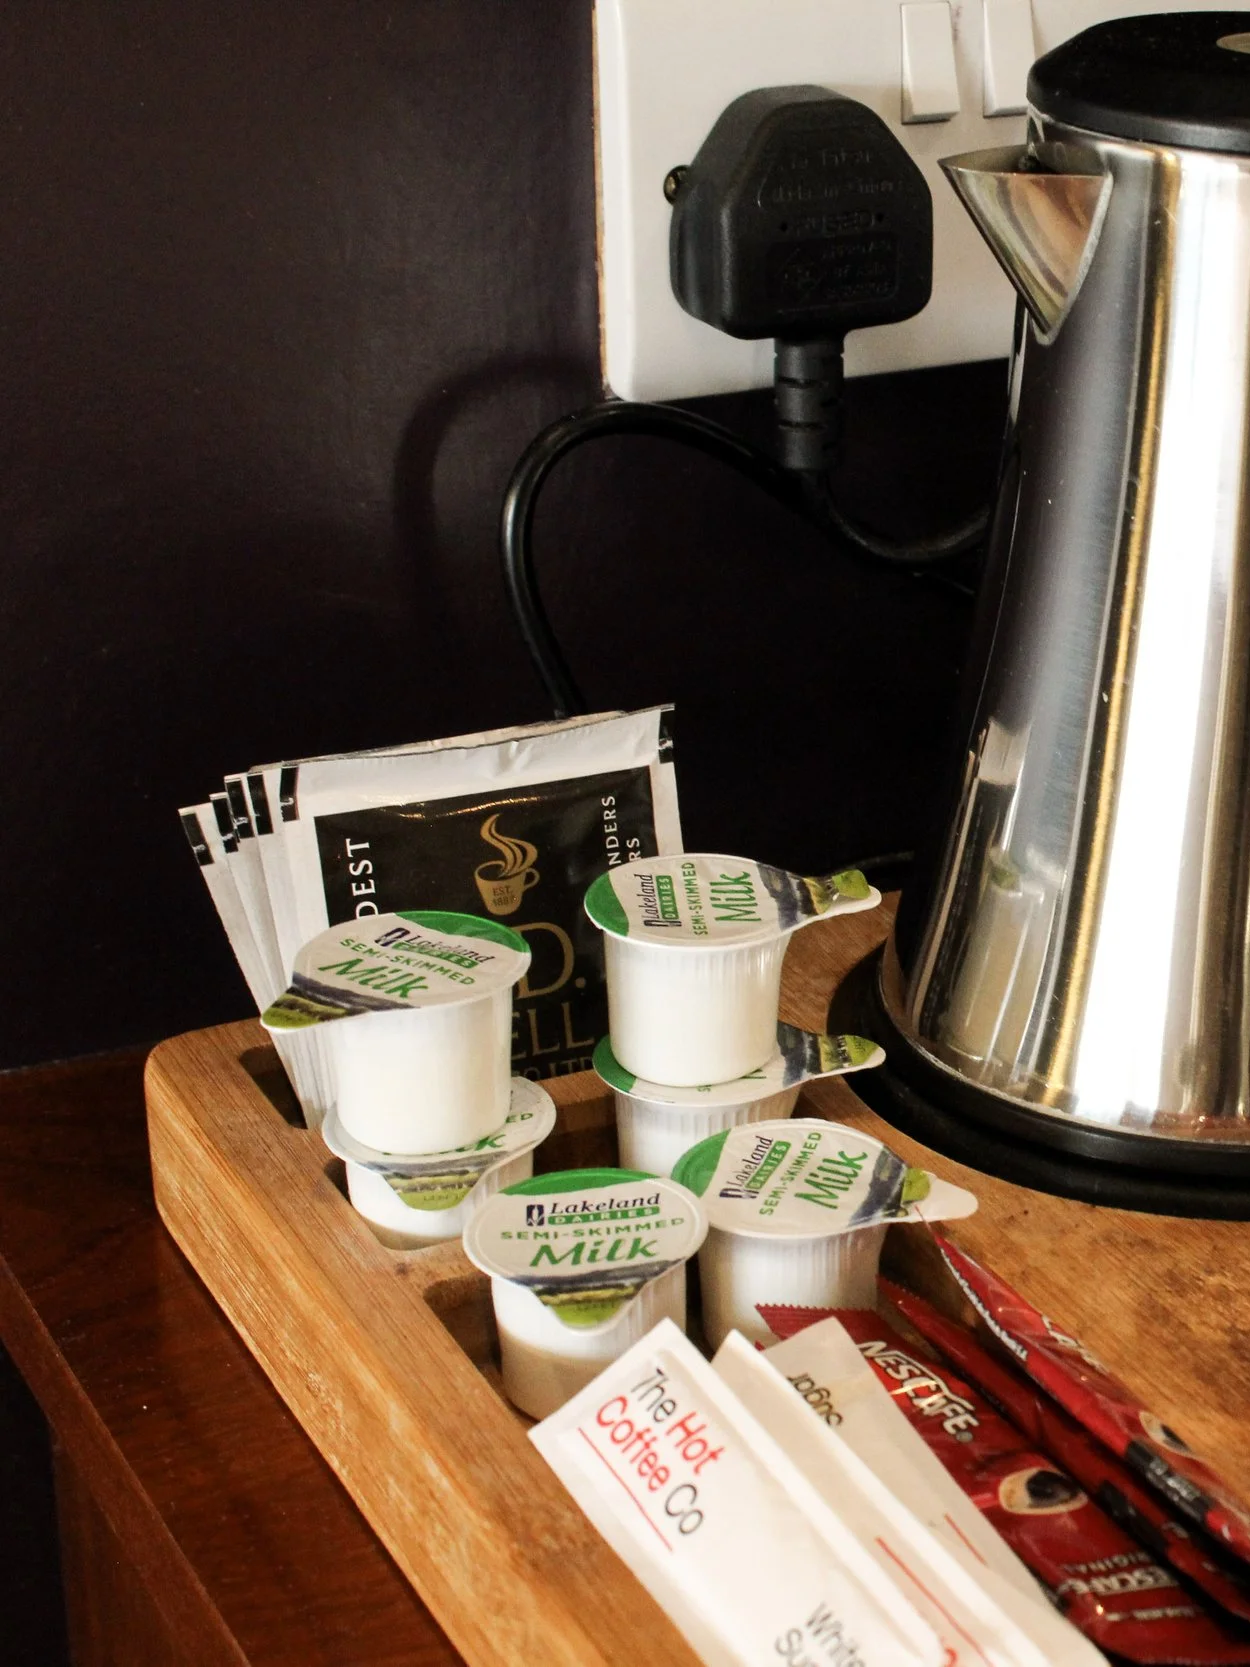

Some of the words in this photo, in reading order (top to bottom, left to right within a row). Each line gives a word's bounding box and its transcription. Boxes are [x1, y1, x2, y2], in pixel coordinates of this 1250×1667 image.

[601, 795, 621, 866] NDERS
[346, 838, 379, 918] DEST
[635, 873, 653, 920] Lakeland
[657, 876, 677, 919] DAIRIES
[681, 862, 708, 936] SEMI-SKIMMED
[709, 871, 762, 923] Milk
[318, 958, 429, 998] Milk
[340, 937, 475, 985] SEMI-SKIMMED
[727, 1135, 773, 1195] Lakeland
[752, 1142, 788, 1190] DAIRIES
[759, 1132, 822, 1216] SEMI-SKIMMED
[794, 1150, 868, 1210] Milk
[501, 1217, 684, 1240] SEMI-SKIMMED
[551, 1193, 660, 1215] Lakeland
[555, 1207, 655, 1225] DAIRIES
[529, 1237, 659, 1267] Milk
[631, 1368, 677, 1423] The
[666, 1412, 725, 1475] Hot
[786, 1373, 843, 1428] Sugar
[596, 1396, 670, 1492] Coffee
[665, 1484, 703, 1535] Co
